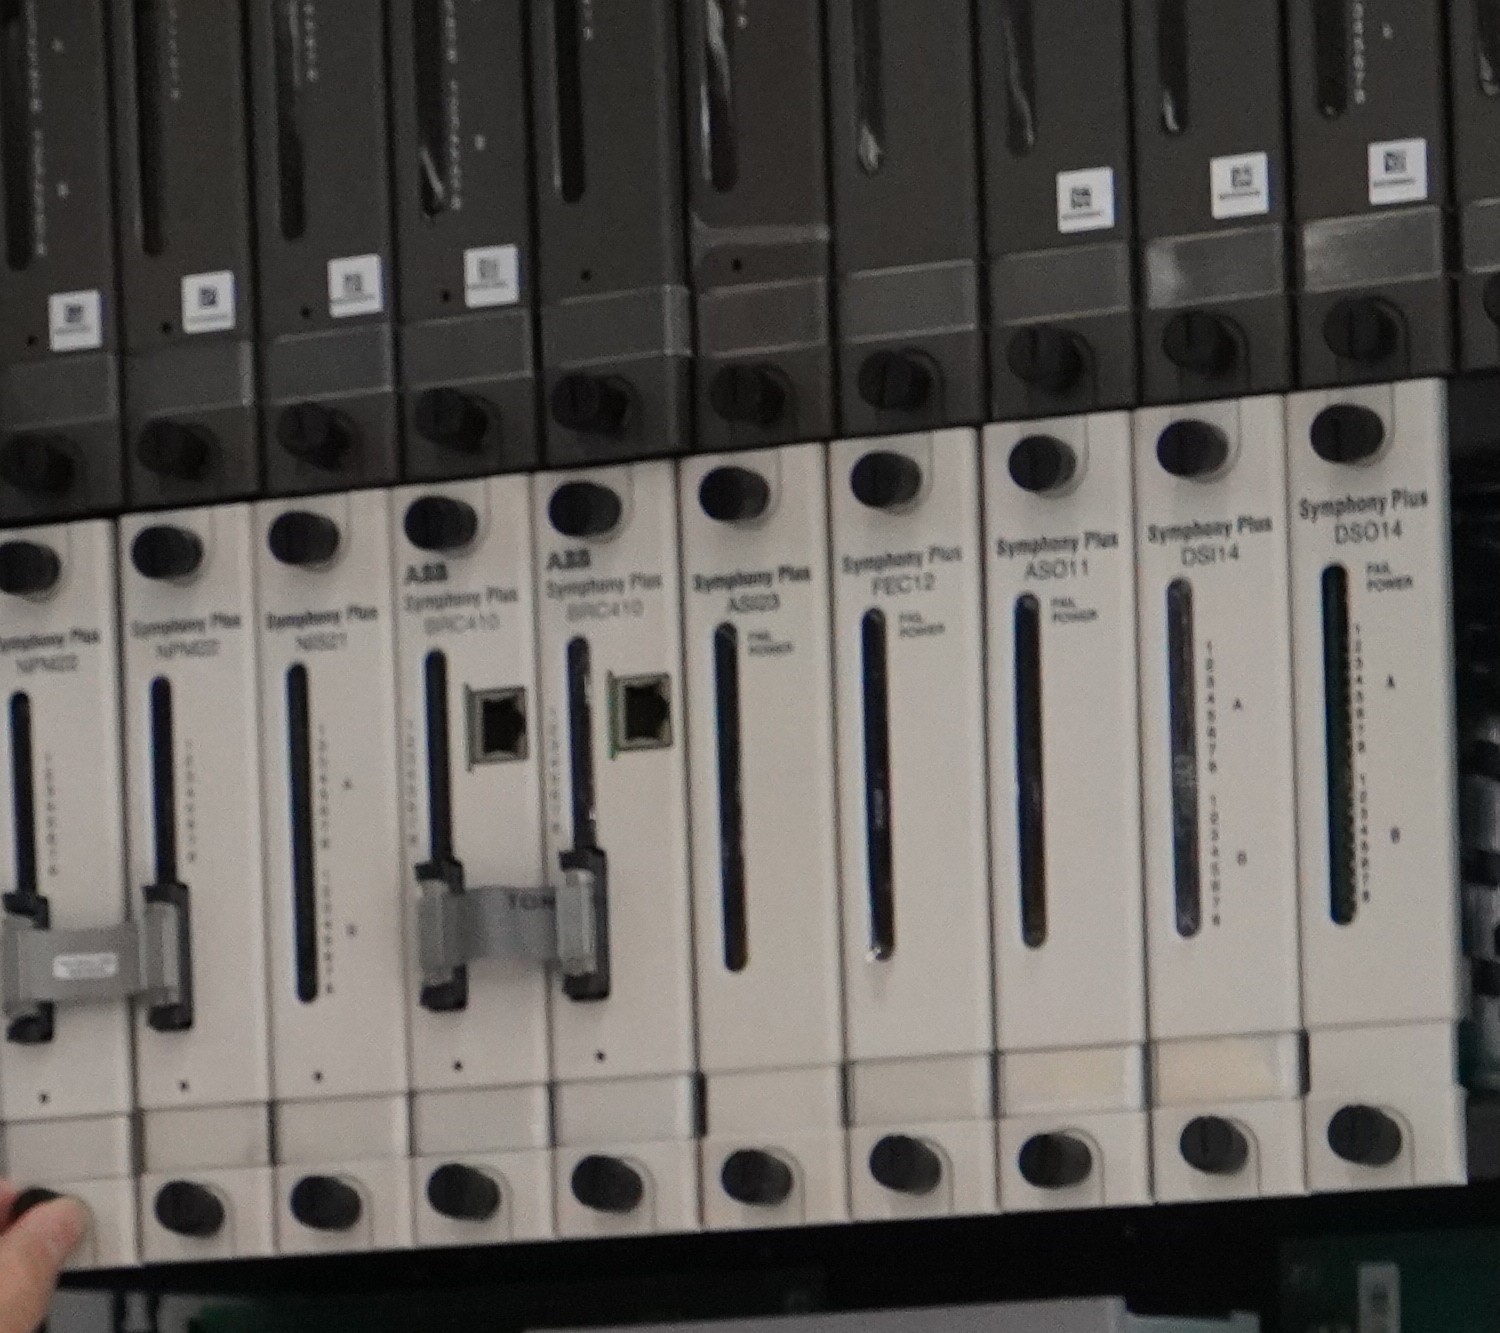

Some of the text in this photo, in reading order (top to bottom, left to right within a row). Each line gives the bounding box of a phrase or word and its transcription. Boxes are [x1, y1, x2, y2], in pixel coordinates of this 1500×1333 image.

[1300, 487, 1428, 523] Symphony Plus
[1148, 514, 1272, 543] Symphony Plus
[1334, 518, 1403, 545] DSO14
[997, 531, 1118, 558] Symphony Plus
[1181, 543, 1240, 567] DSI14
[546, 549, 591, 571] ABB
[842, 544, 962, 575] Symphony Plus
[546, 572, 662, 599] Symphony Plus
[693, 564, 811, 592] Symphony Plus
[403, 586, 518, 613] Symphony Plus
